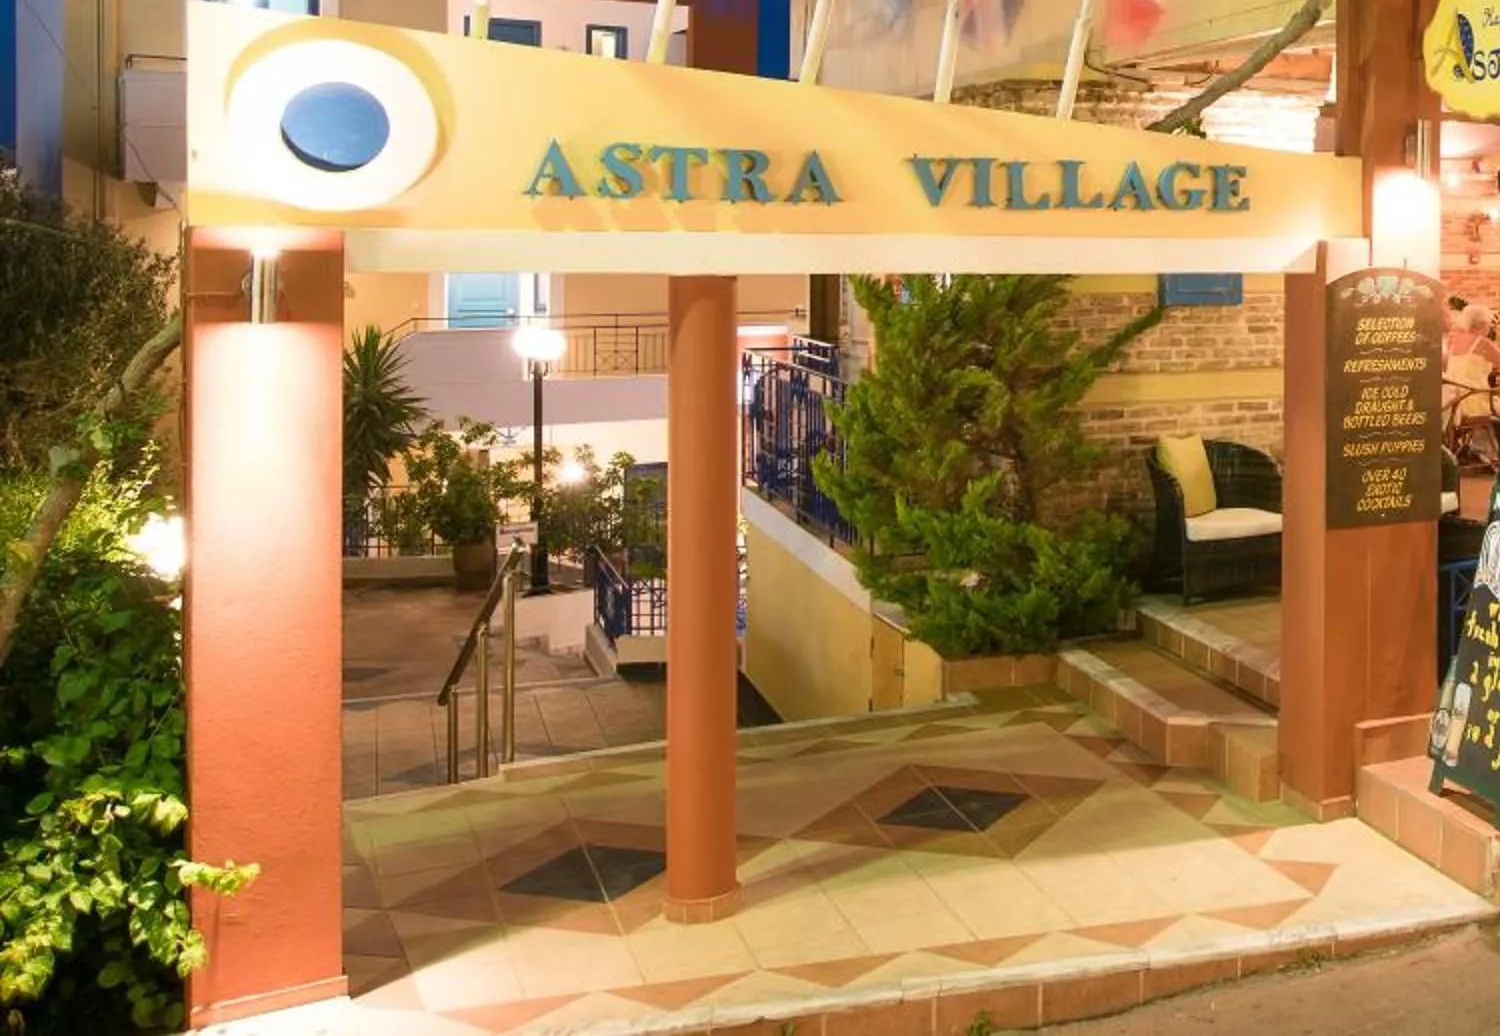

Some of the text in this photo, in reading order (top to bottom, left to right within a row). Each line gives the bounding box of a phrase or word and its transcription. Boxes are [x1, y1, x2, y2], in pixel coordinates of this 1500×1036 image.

[522, 136, 1250, 213] ASTRA VILLAGE
[1356, 317, 1416, 331] SELECTION
[1355, 330, 1417, 345] OF COFFEES
[1343, 357, 1428, 373] REFRESHMENTS
[1361, 385, 1409, 401] ICE COLD
[1354, 400, 1406, 415] DRAUGHT
[1343, 411, 1427, 430] BOTTLED BEERS
[1343, 442, 1379, 457] SLUSH
[1361, 467, 1407, 483] OVER 40
[1365, 482, 1403, 497] EXOTIC
[1356, 494, 1412, 512] COCKTAILS
